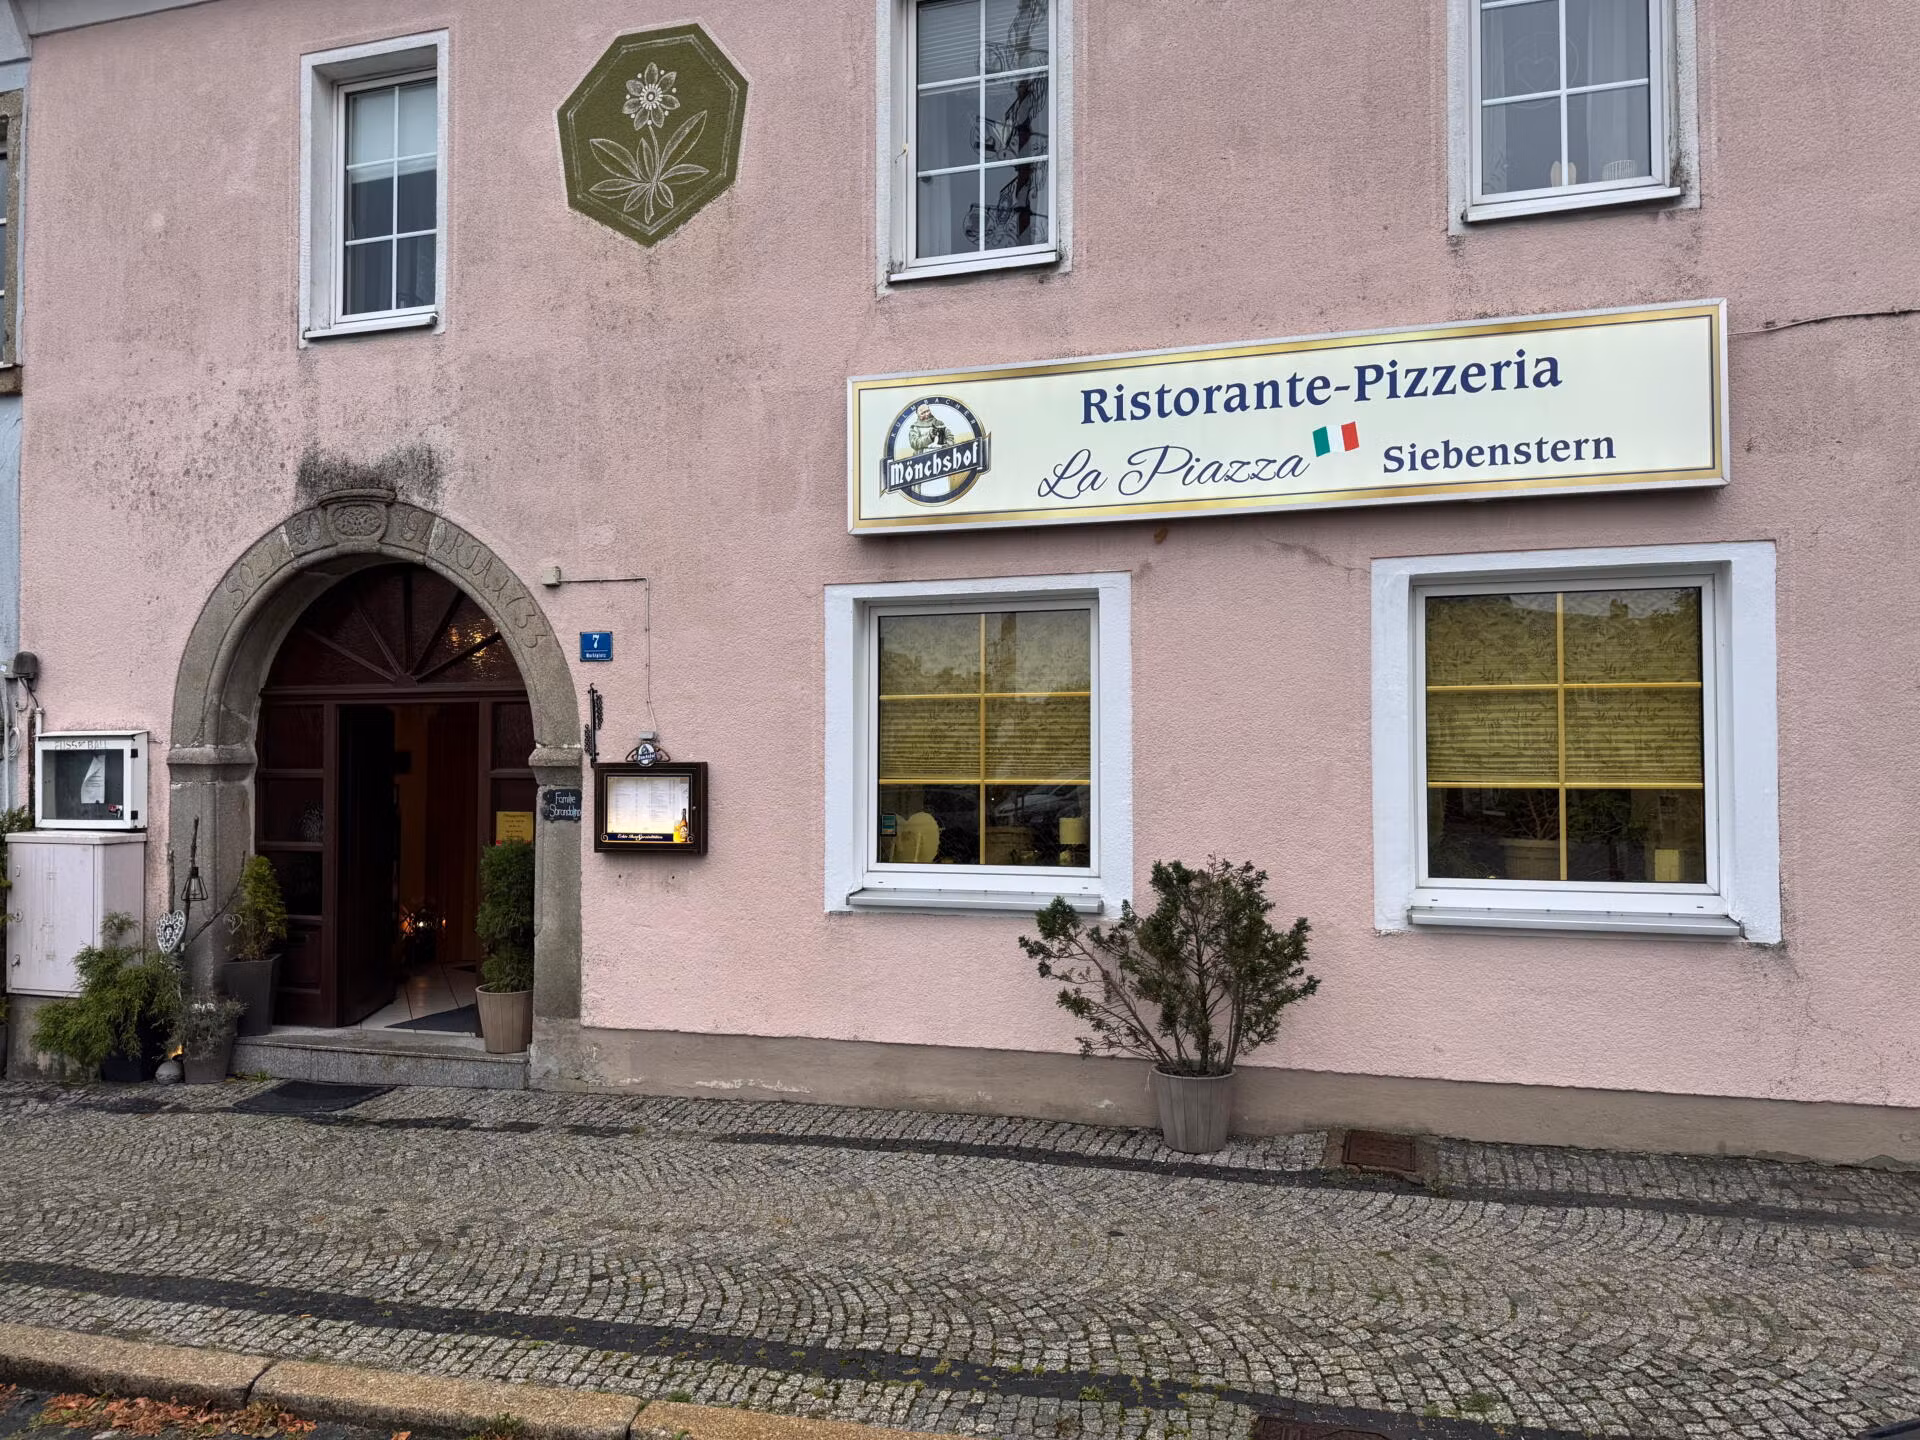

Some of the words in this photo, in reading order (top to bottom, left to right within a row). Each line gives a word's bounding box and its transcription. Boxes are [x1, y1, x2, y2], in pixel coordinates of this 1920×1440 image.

[1080, 348, 1563, 425] Ristorante-Pizzeria
[890, 397, 977, 437] KULMBACHER
[890, 441, 979, 486] Mönchshof
[1037, 448, 1109, 500] La
[1118, 445, 1311, 497] Piazza
[1383, 435, 1616, 473] Siebenstern
[592, 634, 600, 649] 7
